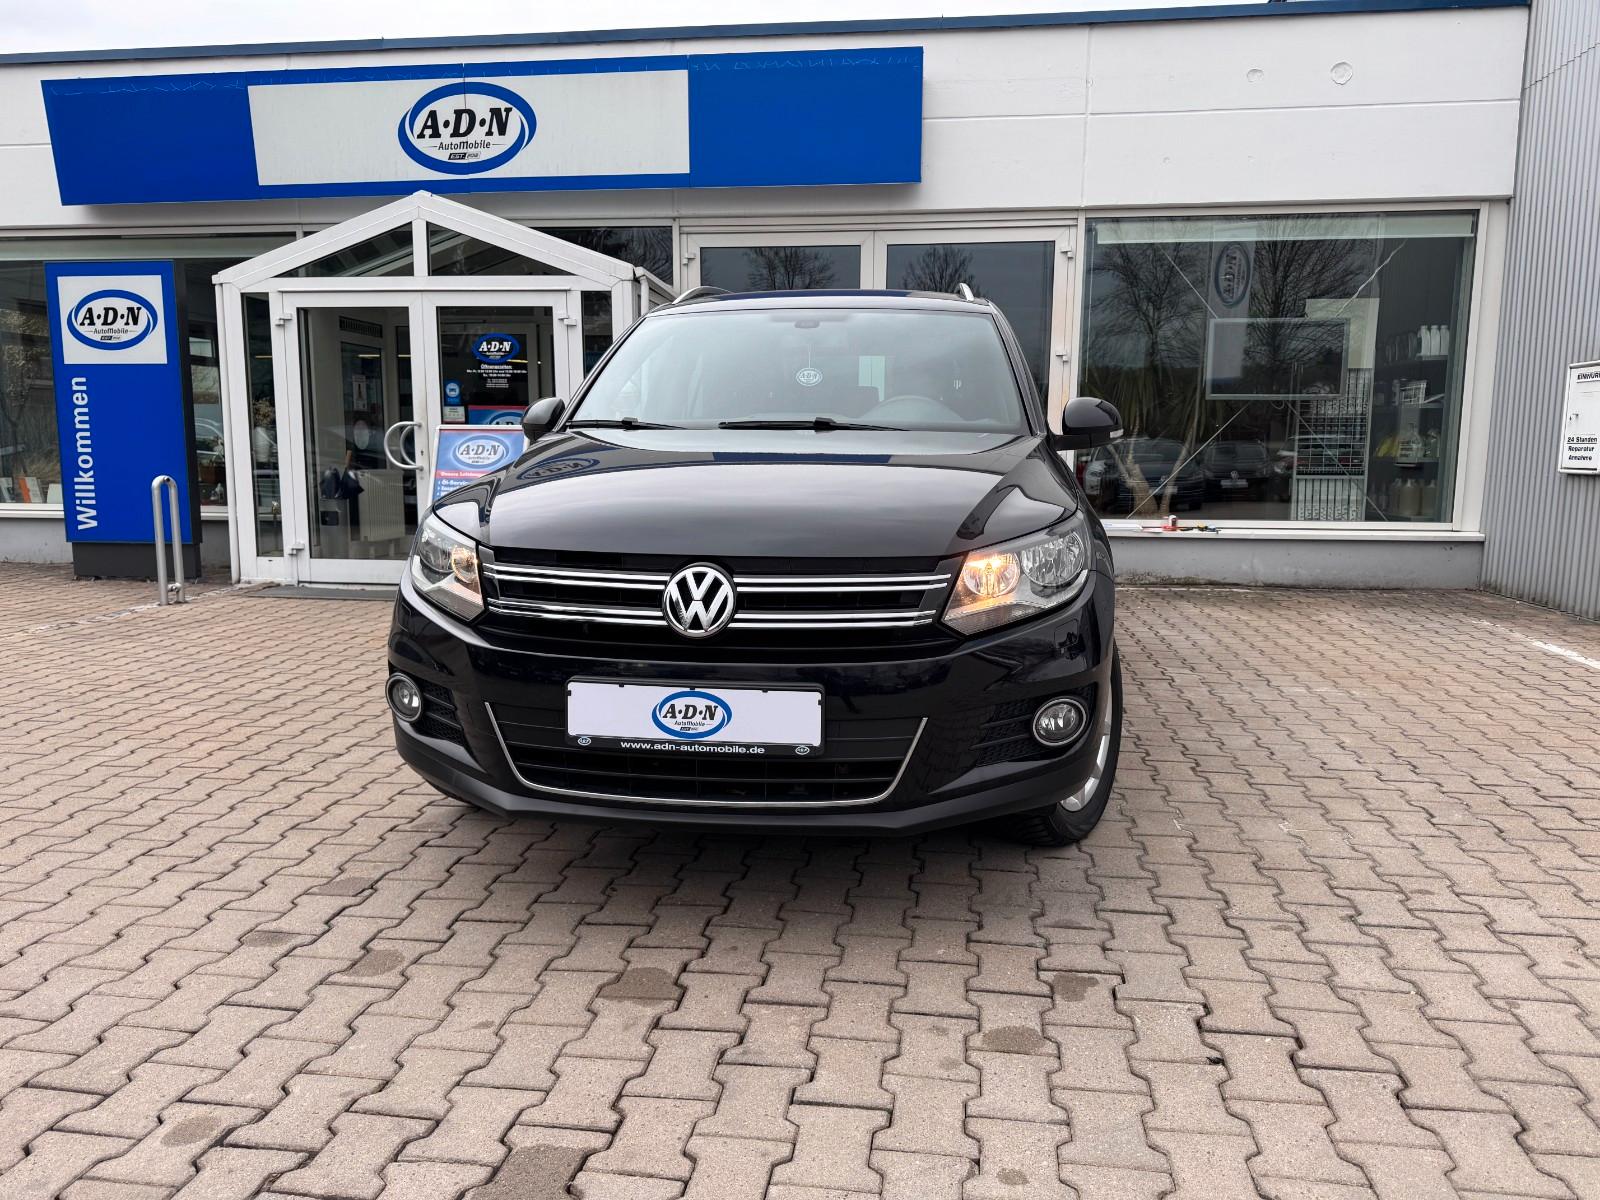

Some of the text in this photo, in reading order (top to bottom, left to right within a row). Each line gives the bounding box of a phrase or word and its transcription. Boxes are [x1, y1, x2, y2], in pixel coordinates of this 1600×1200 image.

[71, 377, 98, 530] Willkommen
[1567, 445, 1595, 453] Reparatur
[620, 741, 765, 754] www.adn-automobile.de
